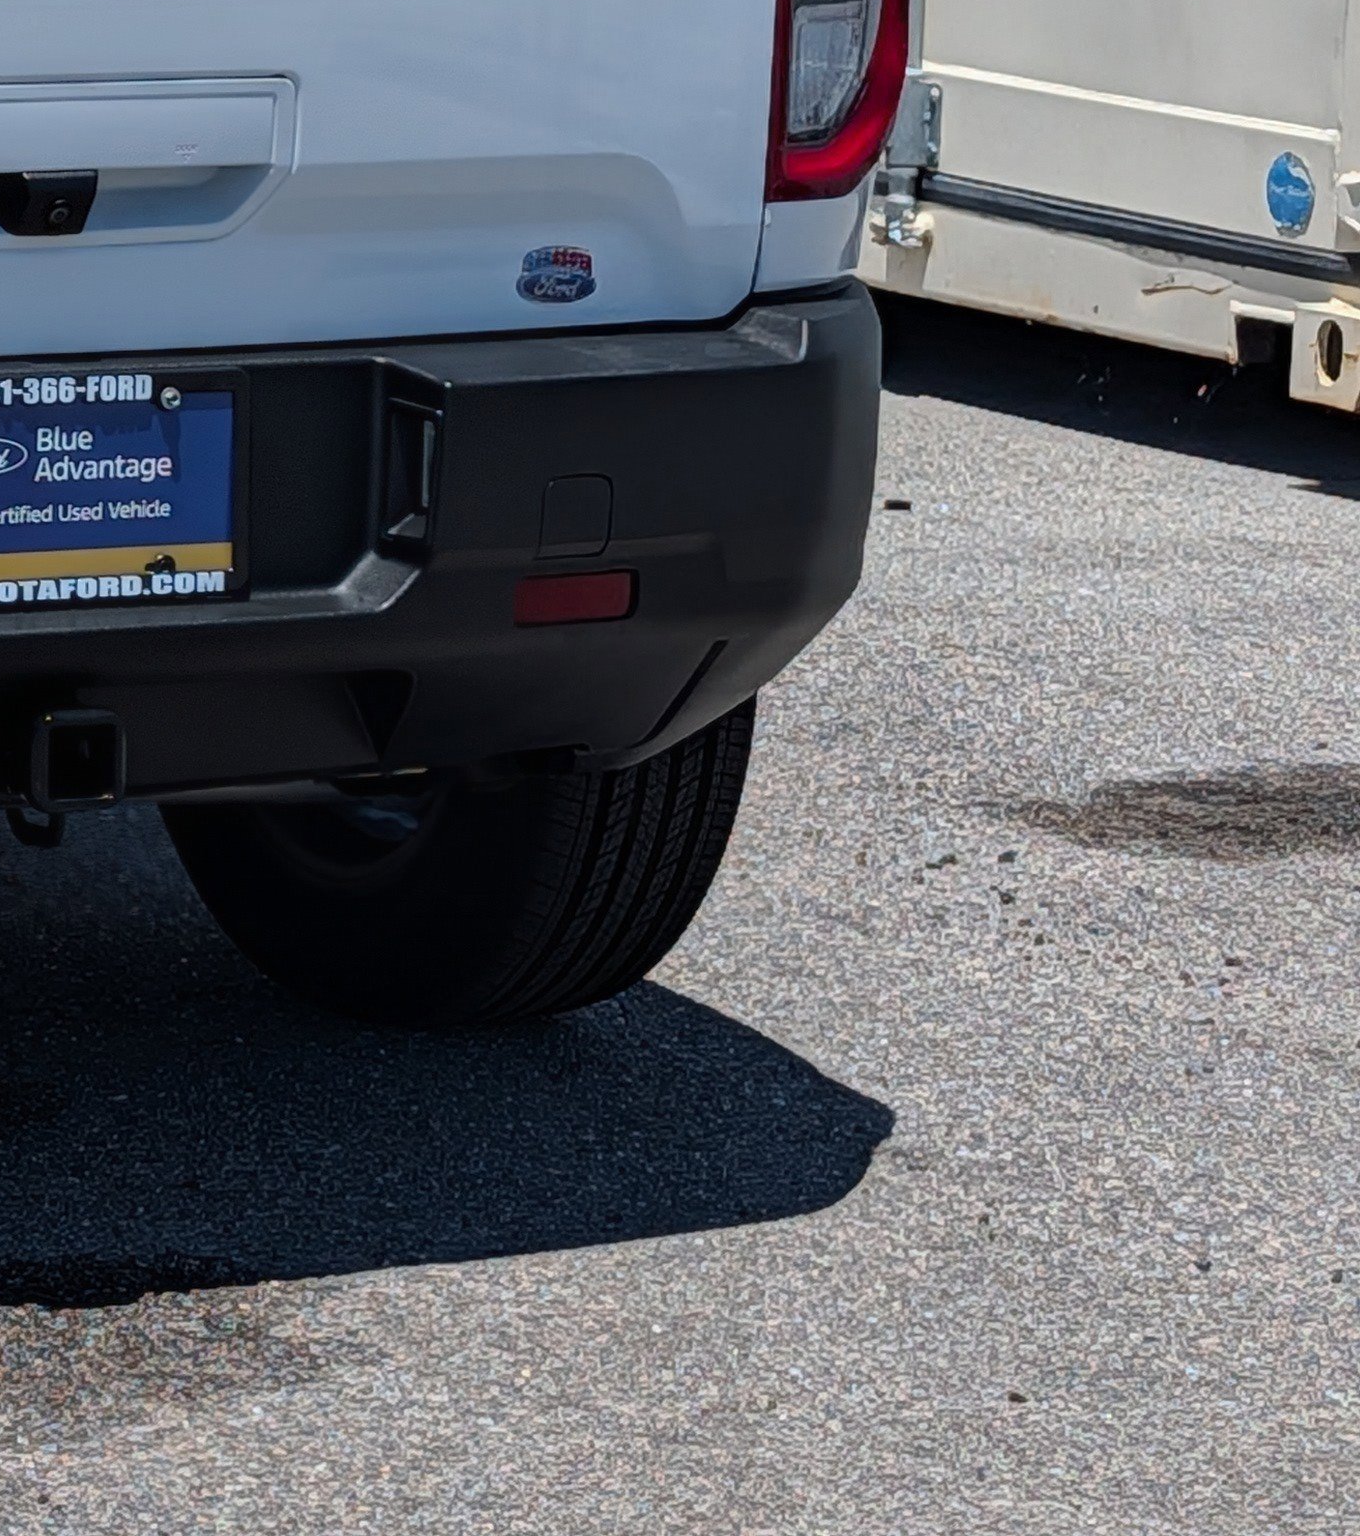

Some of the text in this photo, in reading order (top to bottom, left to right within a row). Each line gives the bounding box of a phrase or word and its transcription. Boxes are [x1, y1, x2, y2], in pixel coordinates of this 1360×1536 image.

[36, 426, 94, 452] Blue
[34, 455, 173, 482] Advantage
[58, 502, 103, 521] Used
[108, 499, 172, 519] Vehicle
